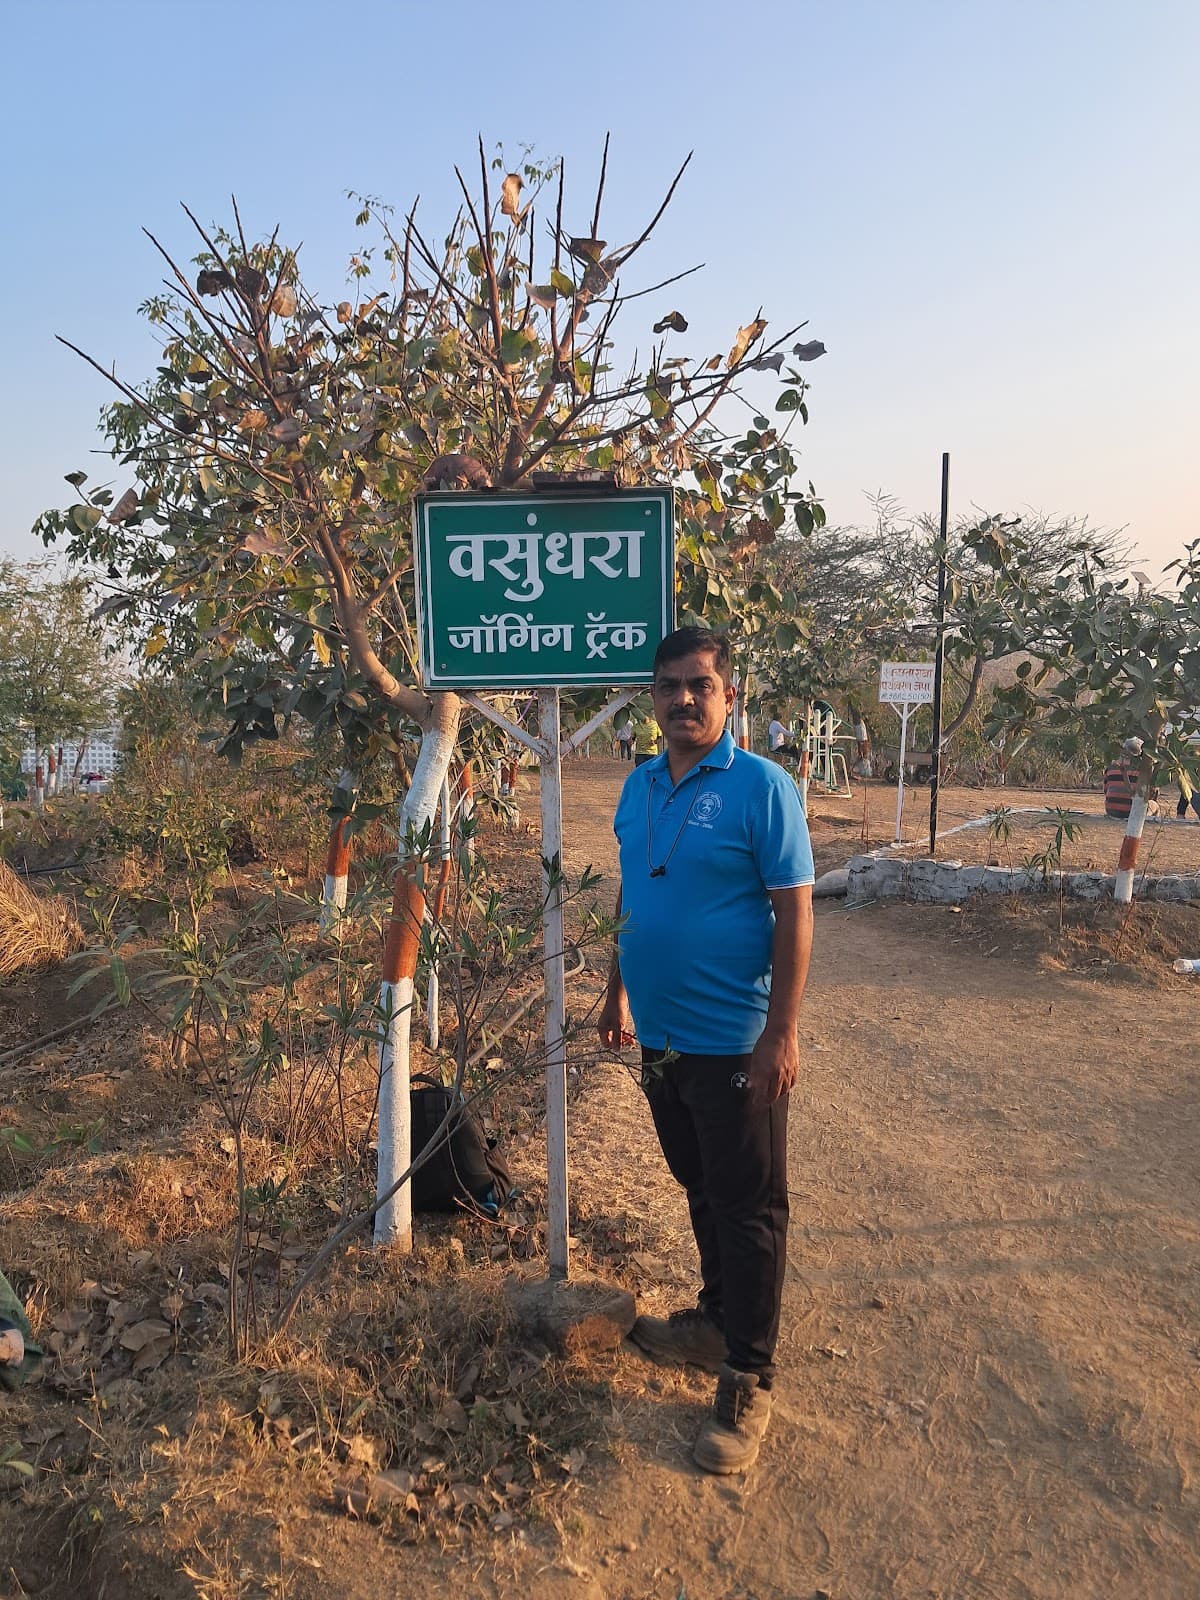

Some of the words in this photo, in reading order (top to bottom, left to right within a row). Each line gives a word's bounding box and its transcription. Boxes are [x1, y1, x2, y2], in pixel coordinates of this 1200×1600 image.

[446, 513, 645, 602] वसुंधरा
[447, 613, 574, 653] जॉगिंग
[584, 611, 648, 659] ट्रॅक
